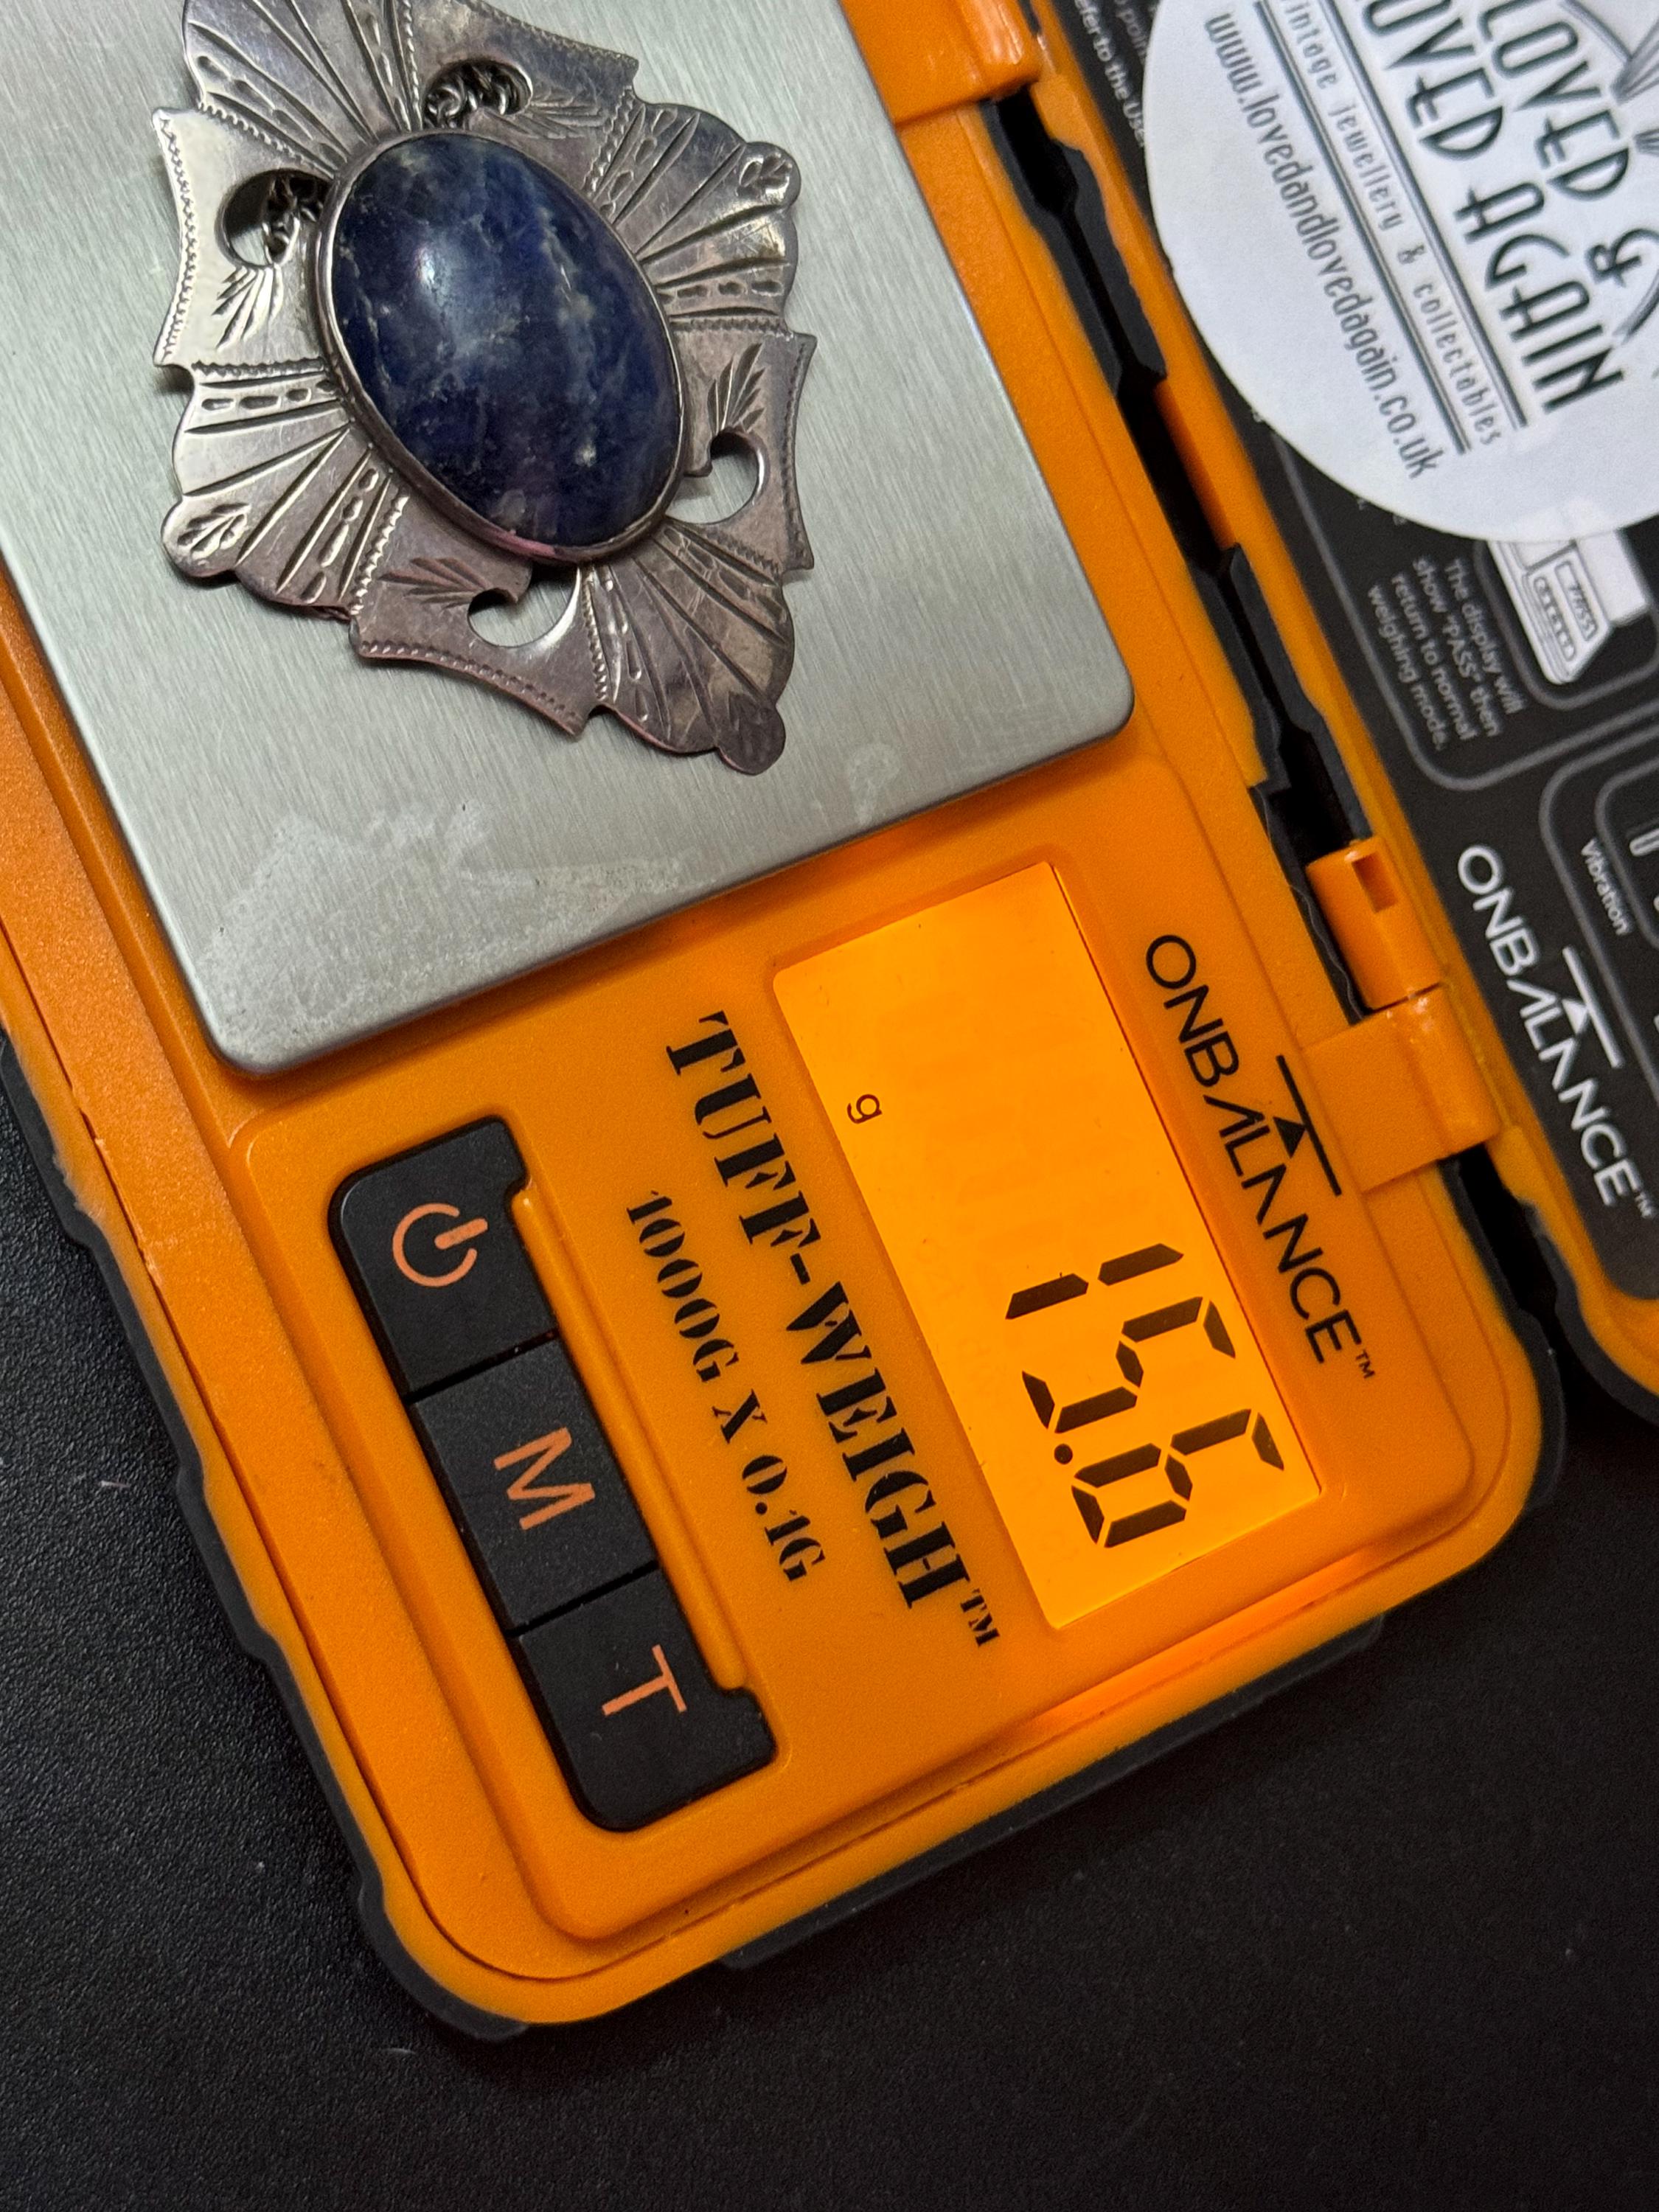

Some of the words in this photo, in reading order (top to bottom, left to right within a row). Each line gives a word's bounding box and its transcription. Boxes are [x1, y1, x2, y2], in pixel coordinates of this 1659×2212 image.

[1093, 38, 1111, 62] to
[1106, 63, 1130, 100] the
[1123, 101, 1144, 147] Use
[1476, 0, 1630, 201] LOVED
[1203, 13, 1443, 479] www.lovedandlovedagain.co.uk
[1328, 104, 1404, 231] jewellery
[1397, 242, 1427, 265] &
[1412, 282, 1502, 445] collectables
[1453, 182, 1624, 414] AGAIN
[1368, 585, 1419, 683] weighing
[1391, 574, 1429, 640] return
[1420, 640, 1438, 666] to
[1431, 667, 1478, 740] normal
[1413, 557, 1448, 613] show
[1470, 686, 1500, 737] then
[1444, 558, 1470, 602] The
[1461, 602, 1503, 673] display
[1494, 675, 1526, 714] will
[1581, 838, 1632, 936] Vibration
[846, 1093, 883, 1124] g
[627, 1191, 740, 1383] 1000G
[742, 1454, 826, 1583] 0.1G
[1005, 1243, 1284, 1548] 15.6
[494, 1427, 597, 1530] M
[602, 1644, 687, 1717] T
